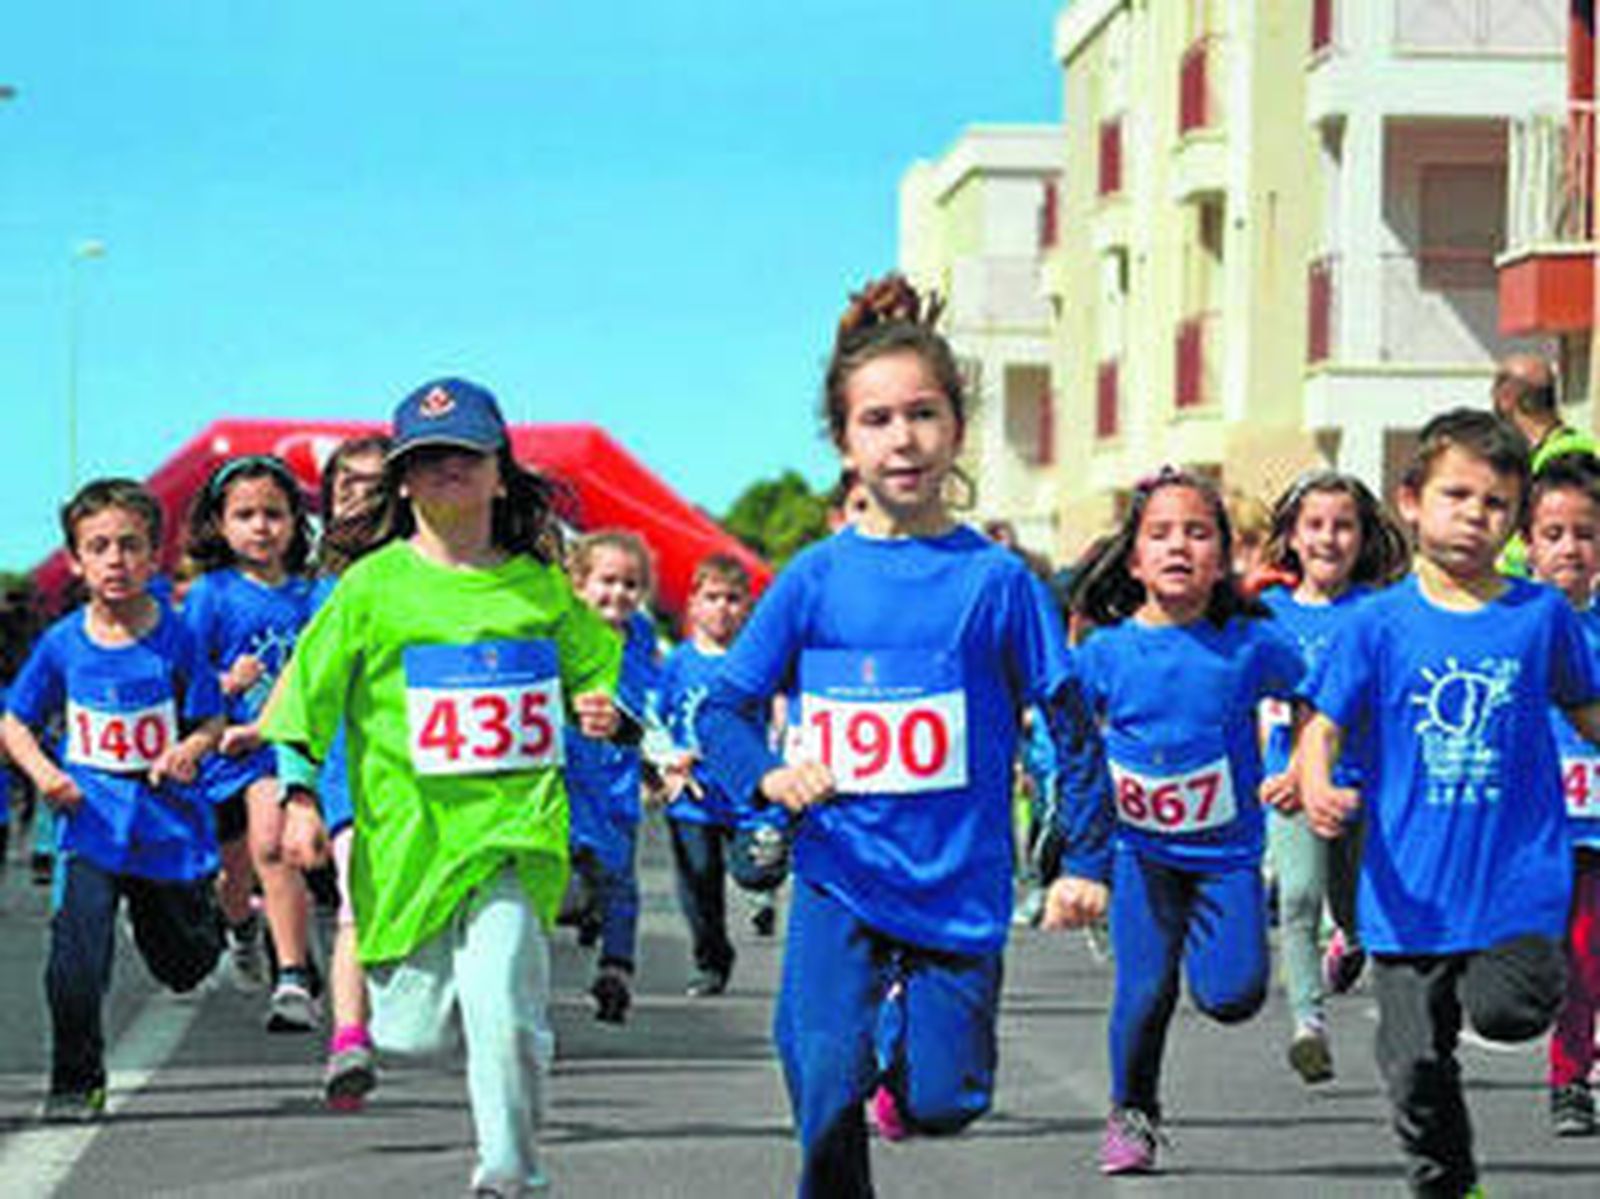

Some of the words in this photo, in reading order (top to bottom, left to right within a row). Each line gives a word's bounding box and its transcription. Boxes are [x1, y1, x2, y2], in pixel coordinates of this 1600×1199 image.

[77, 711, 167, 761] 140
[419, 692, 553, 759] 435
[811, 709, 948, 778] 190
[1120, 772, 1221, 825] 867
[1563, 763, 1600, 808] 4
